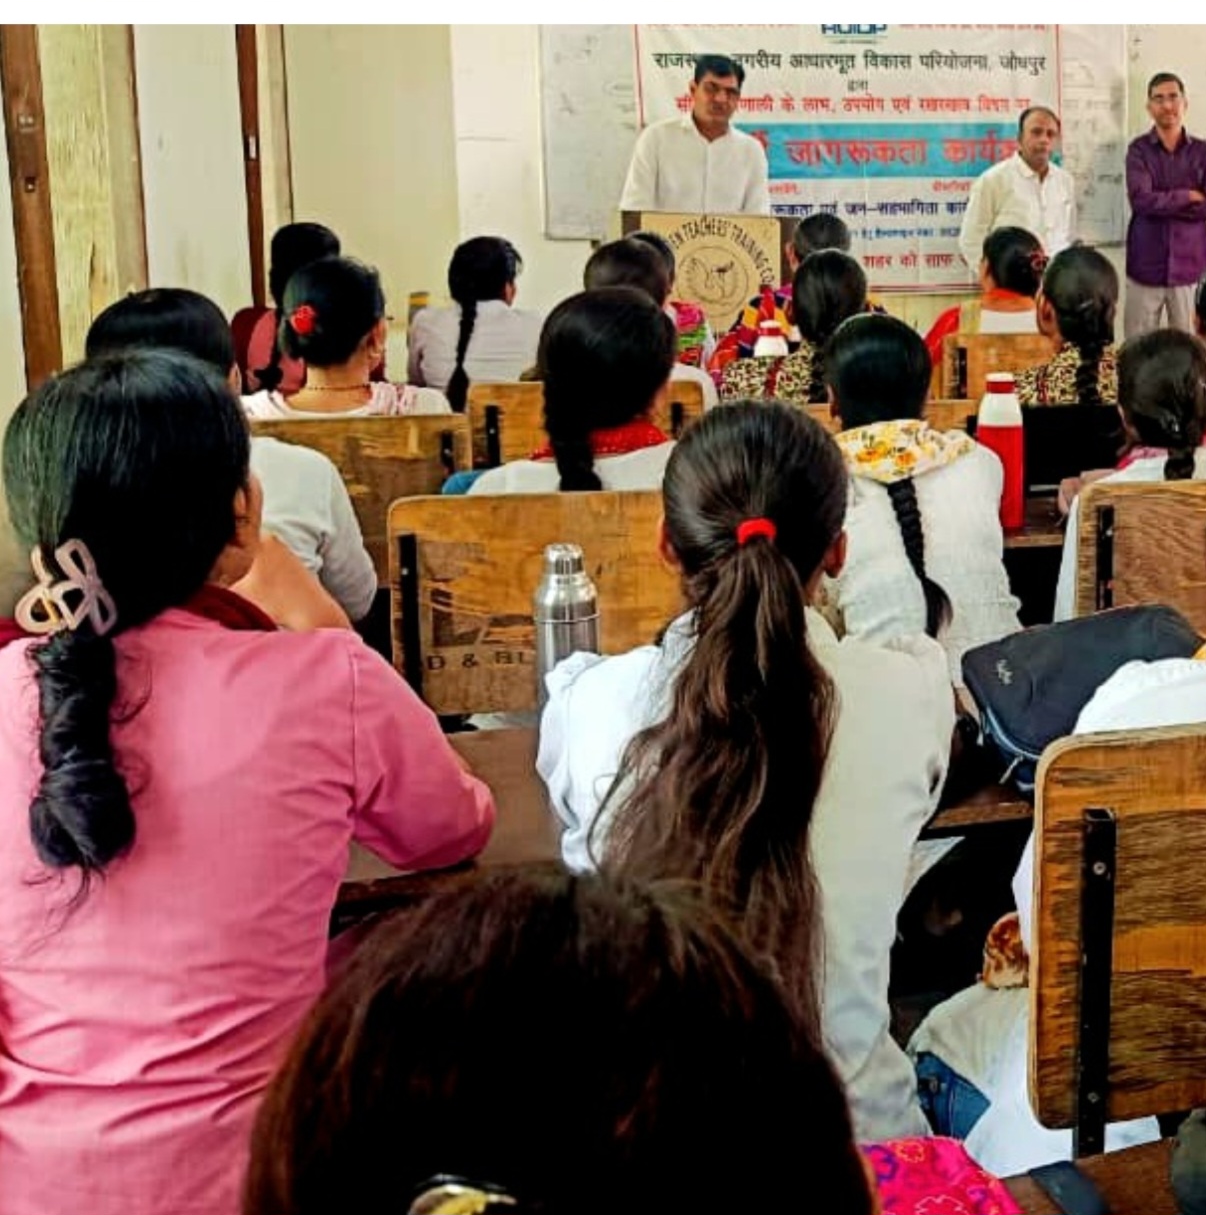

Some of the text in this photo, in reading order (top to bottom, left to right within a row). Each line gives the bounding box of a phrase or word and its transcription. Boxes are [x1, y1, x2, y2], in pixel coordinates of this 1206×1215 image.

[864, 49, 912, 70] विकास
[999, 50, 1046, 76] जोधपुर
[781, 92, 795, 113] के
[785, 139, 928, 166] जागरूकता
